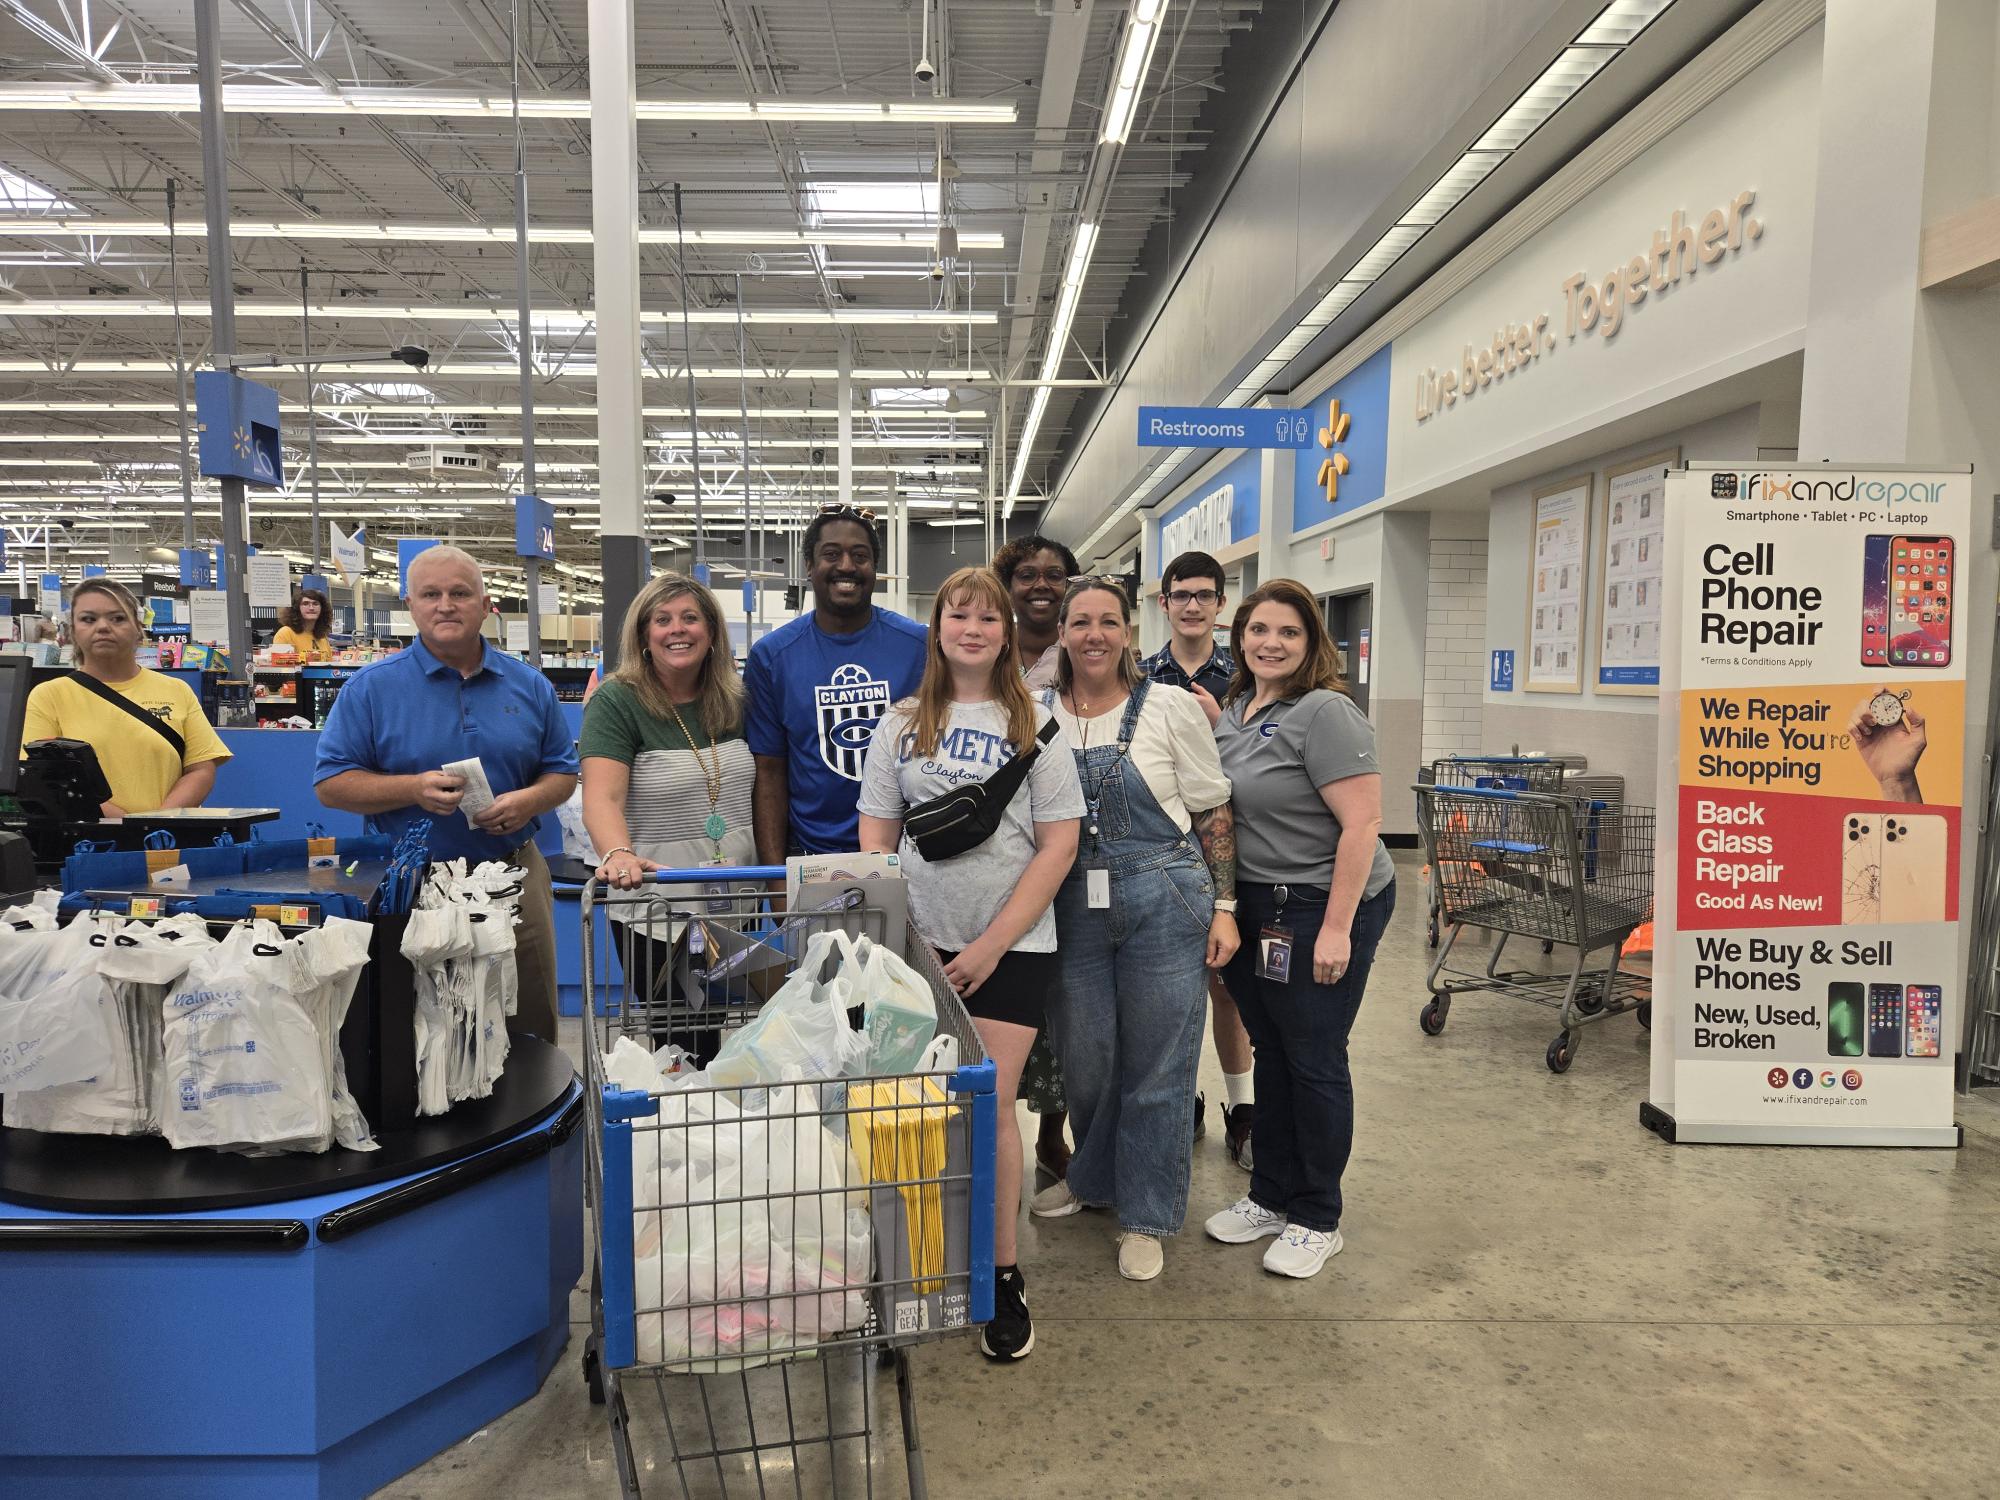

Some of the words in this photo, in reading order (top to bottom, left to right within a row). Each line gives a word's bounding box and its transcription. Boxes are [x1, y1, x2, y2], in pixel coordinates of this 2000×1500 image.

[1415, 367, 1458, 421] Live
[1461, 313, 1557, 395] better.
[1562, 190, 1764, 338] Together.
[1150, 418, 1245, 438] Restrooms
[1738, 473, 1947, 508] ifixandrepair
[1726, 510, 1800, 523] Smartphone
[1811, 511, 1847, 522] Tablet
[1859, 512, 1876, 522] PC
[1888, 513, 1928, 525] Laptop
[542, 527, 553, 553] 24
[1703, 543, 1774, 576] Cell
[153, 581, 176, 592] Reebok
[1701, 578, 1822, 611] Phone
[1701, 613, 1823, 652] Repair
[1733, 658, 1740, 667] &
[1741, 658, 1786, 667] Conditions
[1788, 658, 1813, 669] Apply
[820, 687, 885, 704] CLAYTON
[1700, 698, 1740, 720] We
[1747, 699, 1831, 728] Repair
[899, 727, 1020, 768] CMETS
[1700, 727, 1770, 750] While
[921, 760, 984, 784] Clayton
[1699, 755, 1821, 786] Shopping
[1697, 801, 1765, 825] Back
[1696, 829, 1773, 854] Glass
[1696, 858, 1784, 889] Repair
[1696, 893, 1745, 910] Good
[1750, 894, 1774, 910] As
[1778, 895, 1823, 911] New!
[1696, 938, 1742, 962] We
[1749, 939, 1803, 970] Buy
[1810, 940, 1833, 965] &
[1841, 941, 1892, 966] Sell
[1695, 965, 1801, 992] Phones
[1694, 1003, 1749, 1029] New,
[1755, 1004, 1821, 1030] Used,
[1694, 1028, 1776, 1050] Broken
[1762, 1093, 1868, 1107] www.ifixandrepair.com
